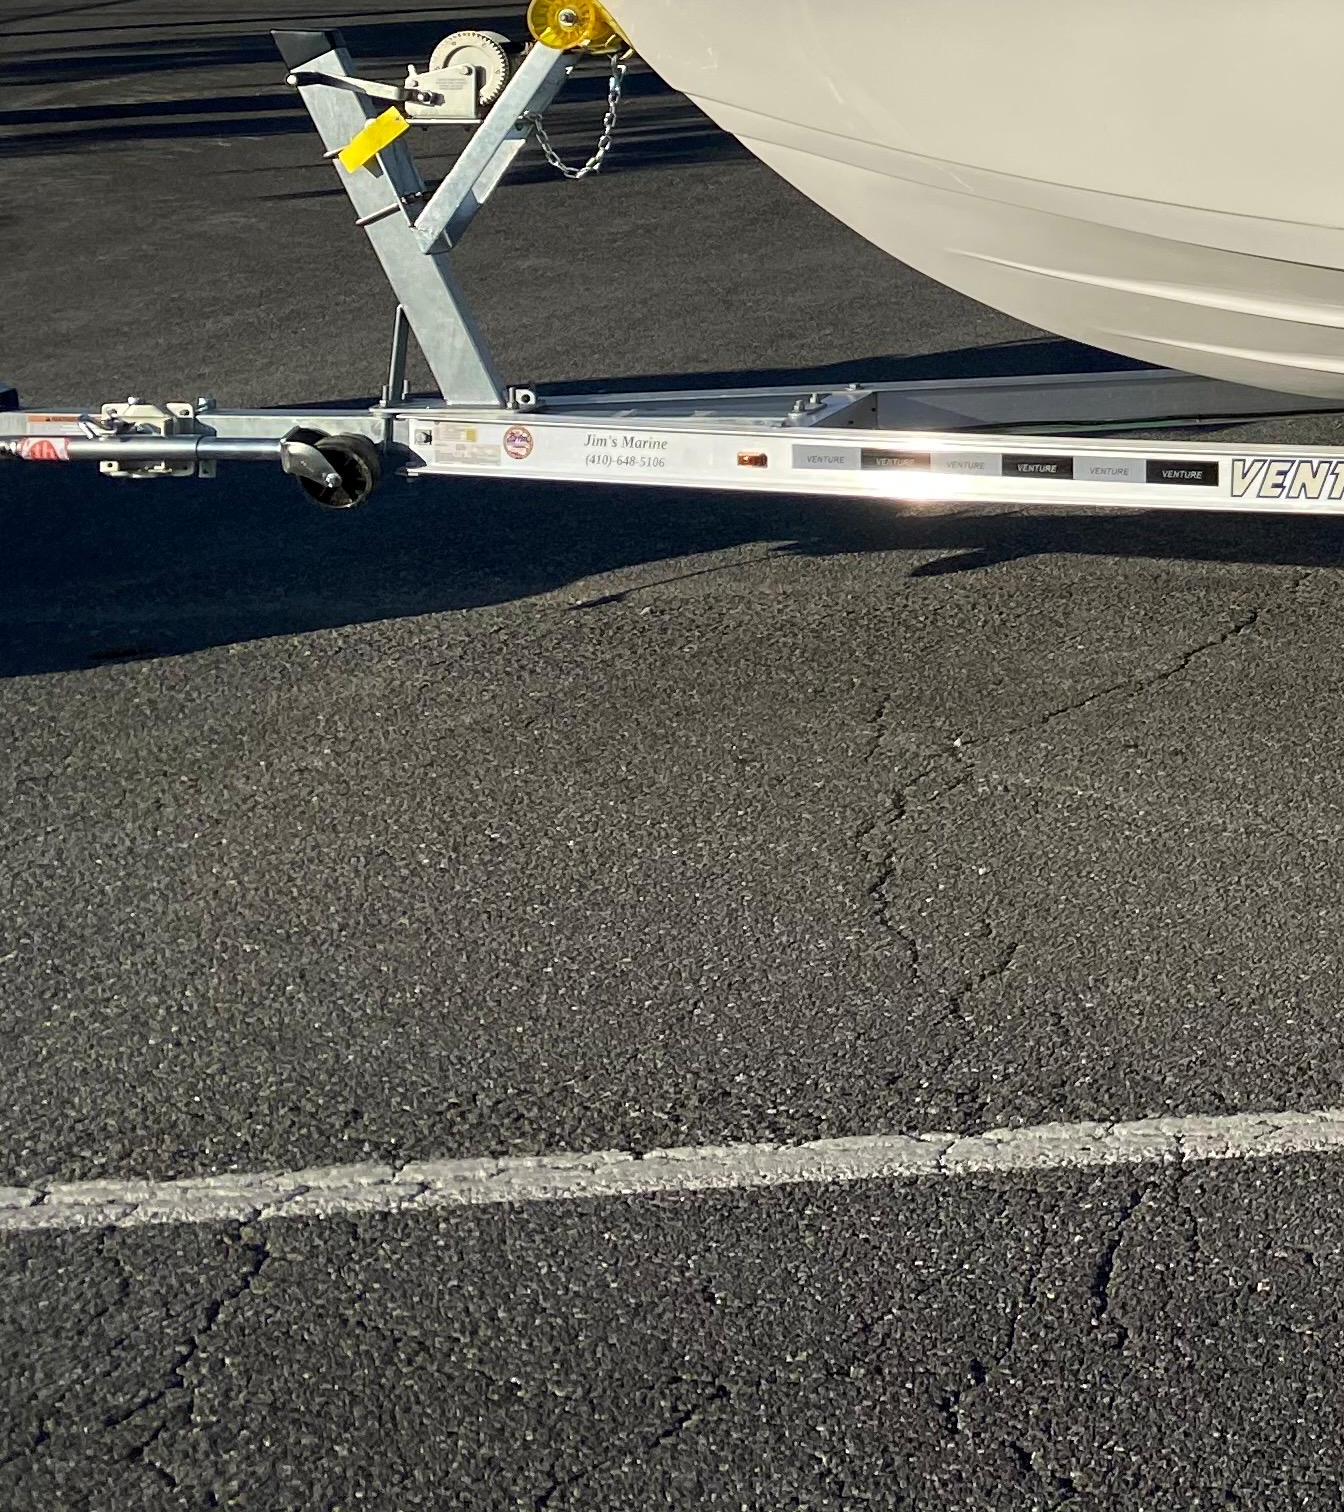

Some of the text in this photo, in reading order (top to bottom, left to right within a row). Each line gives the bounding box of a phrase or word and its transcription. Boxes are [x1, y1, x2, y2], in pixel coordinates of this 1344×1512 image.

[584, 434, 668, 449] Jim's Marine
[807, 455, 845, 464] VENTURE
[947, 461, 985, 470] VENTURE
[1017, 463, 1057, 473] VENTURE
[1089, 466, 1129, 476] VENTURE
[1162, 469, 1203, 479] VENTURE
